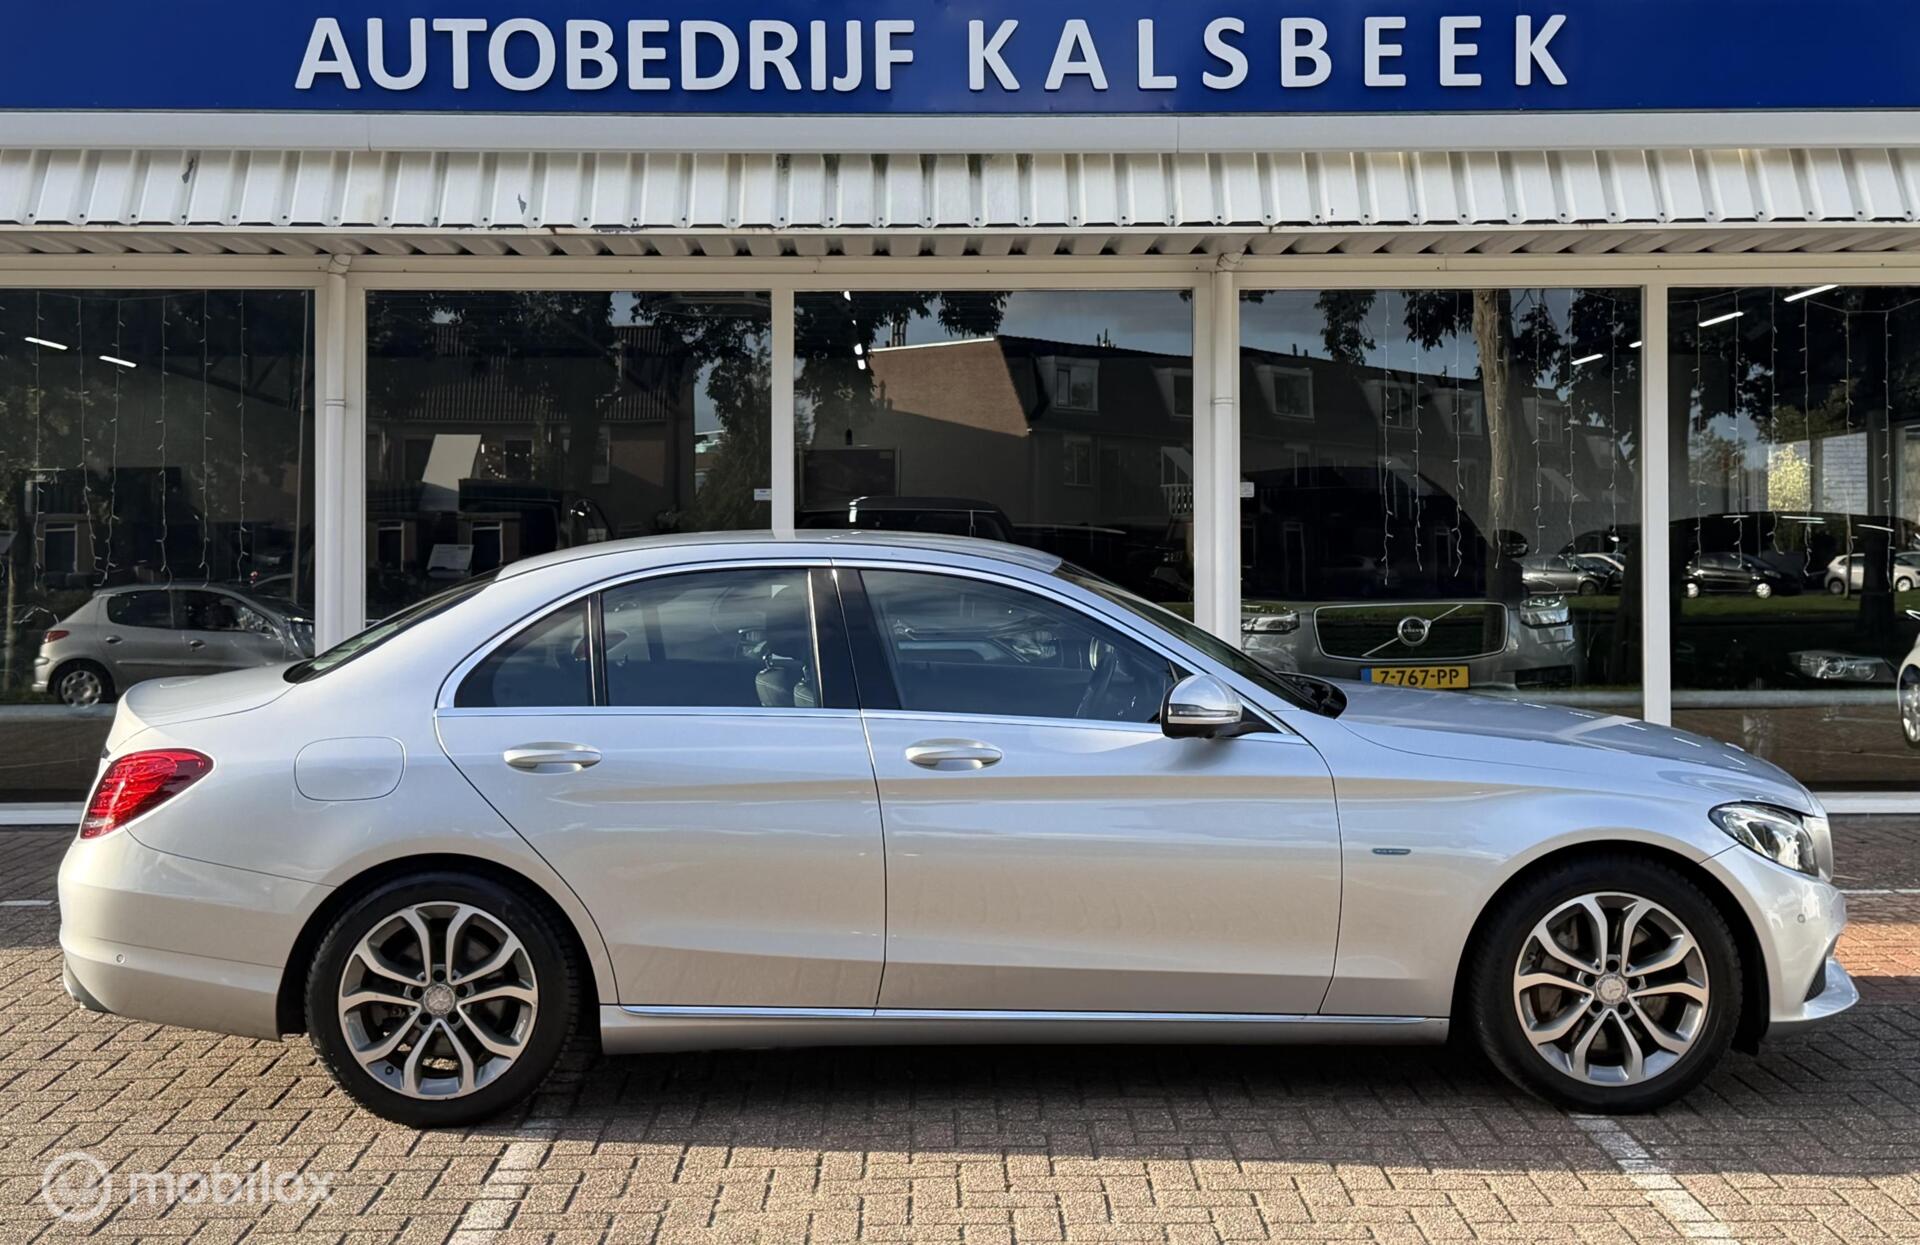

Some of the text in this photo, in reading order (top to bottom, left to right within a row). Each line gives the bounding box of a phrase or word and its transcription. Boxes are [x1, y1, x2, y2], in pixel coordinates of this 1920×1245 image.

[294, 14, 1568, 92] AUTOBEDRIJF KALSBEEK
[1379, 668, 1460, 686] 7-767-PP
